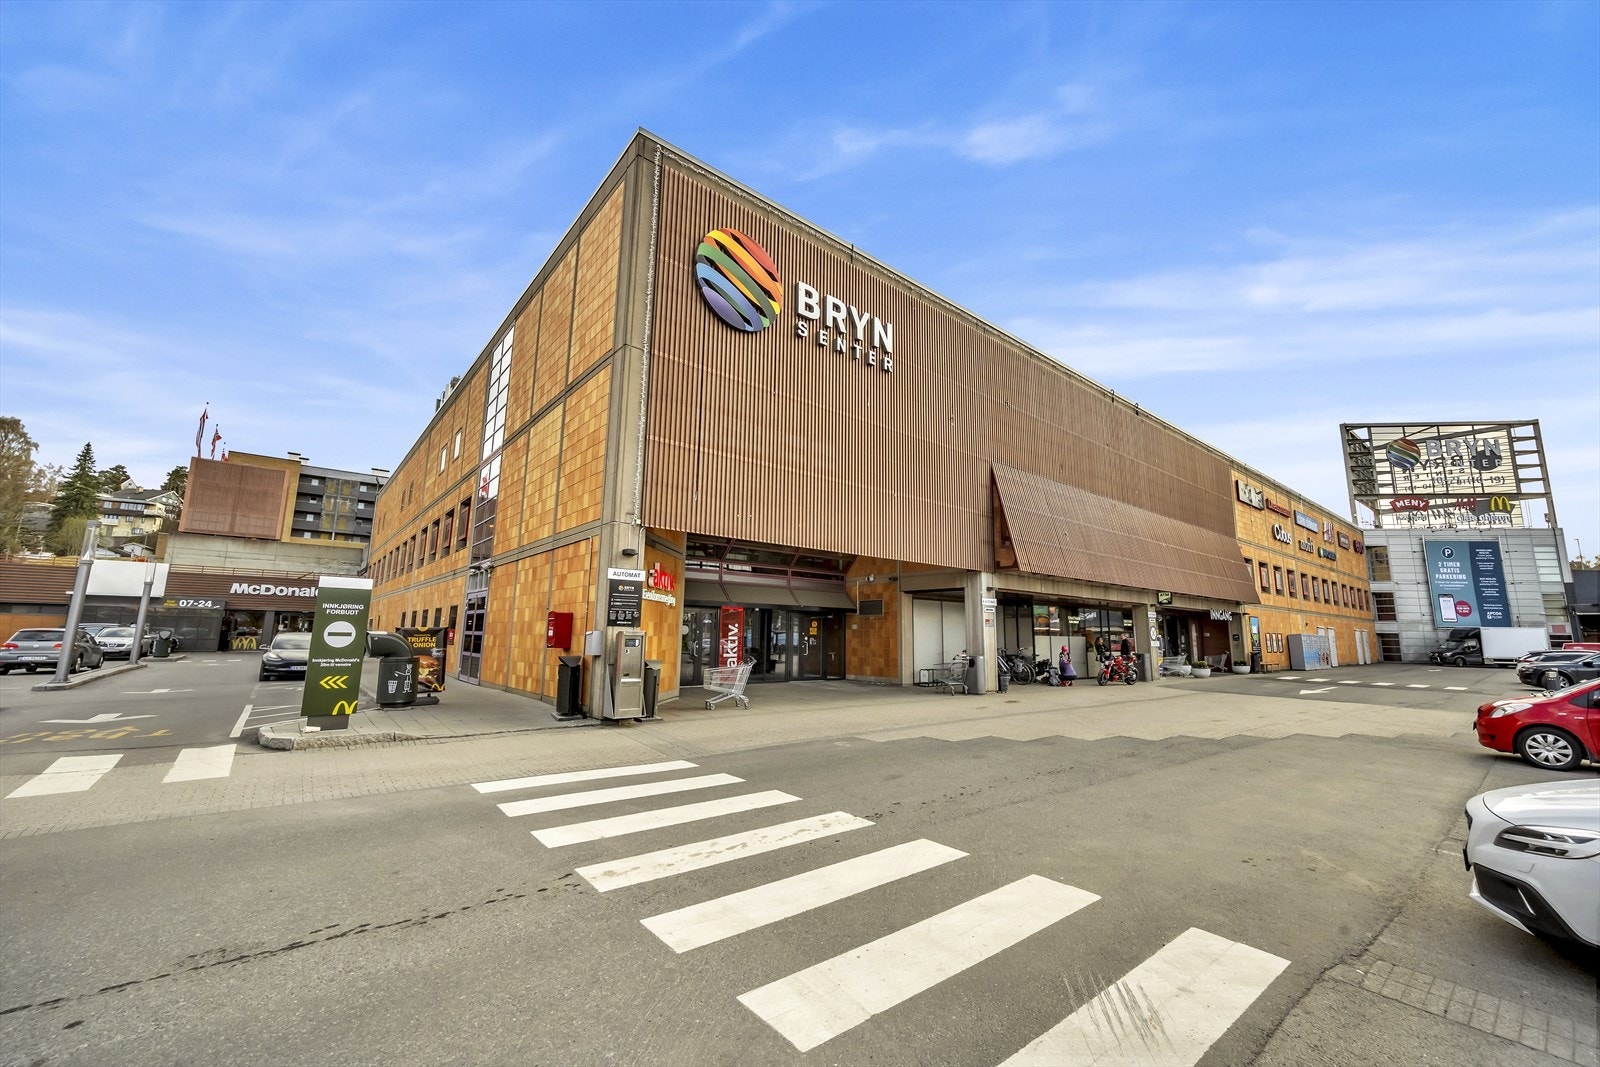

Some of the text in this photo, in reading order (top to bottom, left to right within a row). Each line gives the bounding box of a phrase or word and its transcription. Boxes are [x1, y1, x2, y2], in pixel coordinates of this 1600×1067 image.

[797, 281, 893, 353] BRYN
[797, 320, 893, 372] SENTER
[1426, 438, 1500, 457] BRYN
[1429, 458, 1502, 468] SENTER
[1395, 499, 1426, 508] MENY
[229, 582, 319, 597] McDonal
[178, 600, 212, 608] 07-24
[1210, 608, 1233, 621] INNGANG
